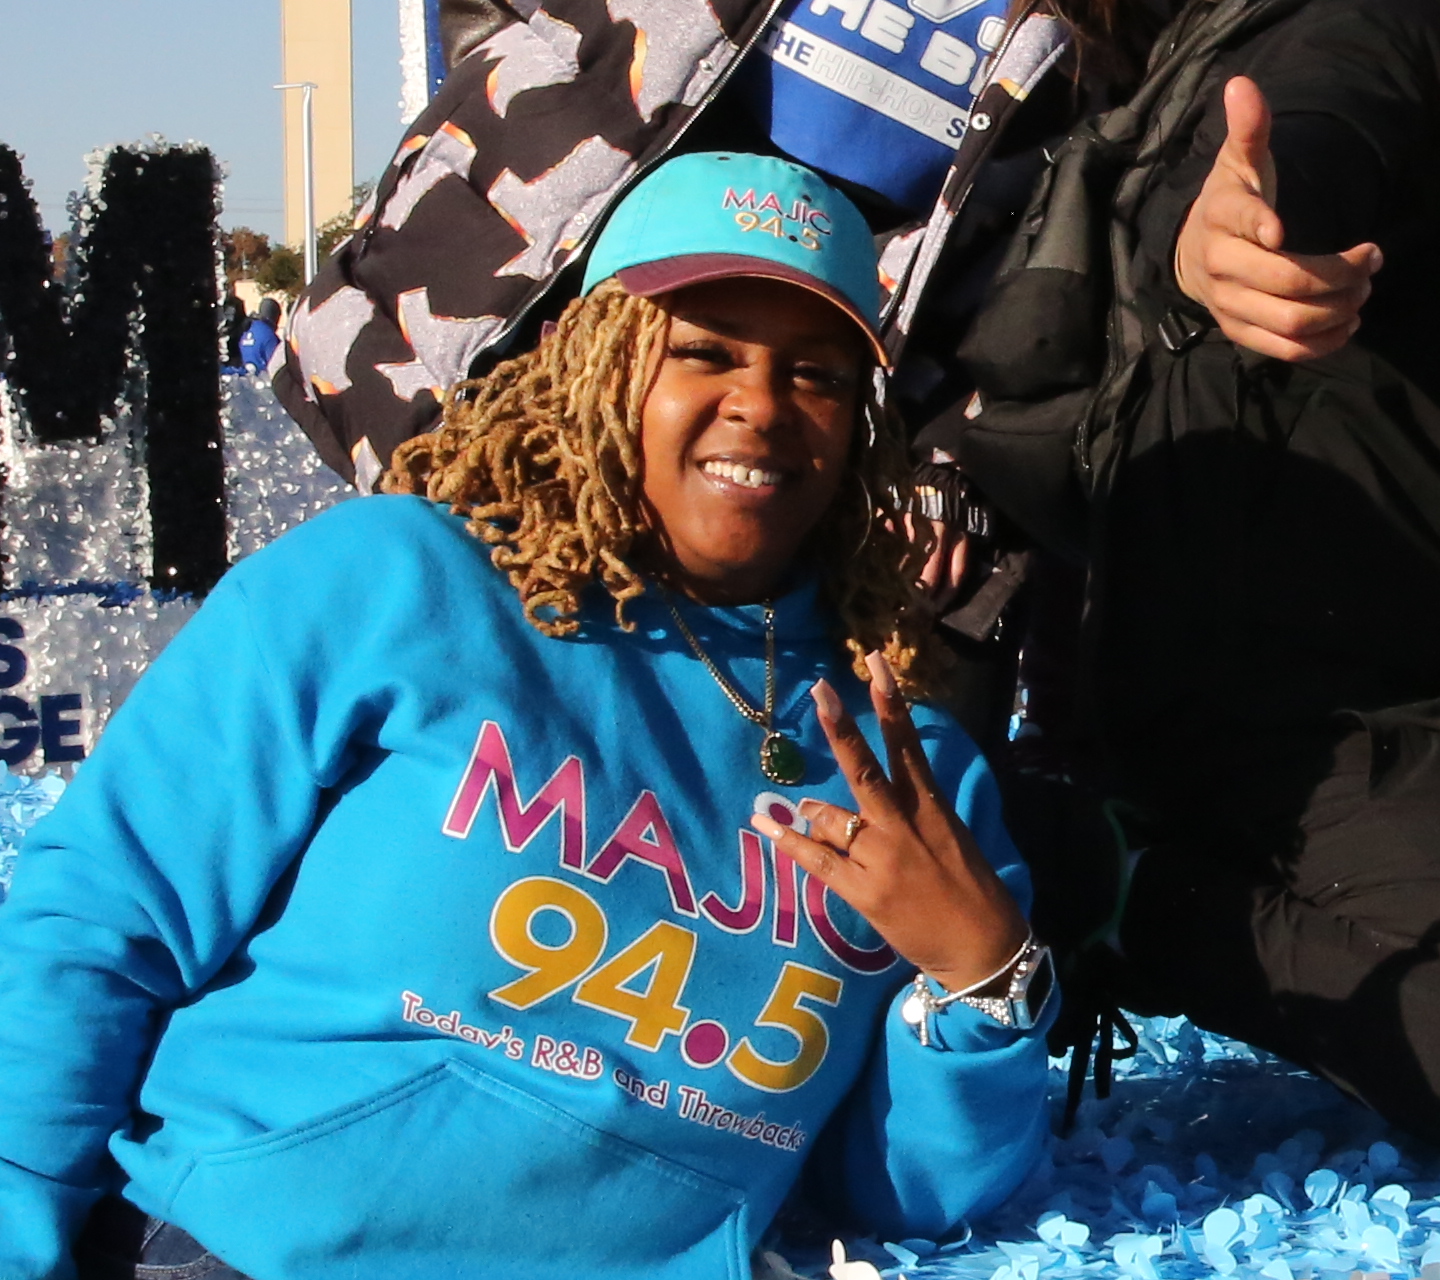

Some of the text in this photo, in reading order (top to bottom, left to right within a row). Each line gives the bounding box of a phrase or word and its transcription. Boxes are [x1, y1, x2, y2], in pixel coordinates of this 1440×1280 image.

[721, 186, 832, 237] MAJIC
[733, 211, 822, 252] 94.5
[488, 875, 843, 1094] 94.5
[400, 990, 808, 1152] Today's R&B and Throwbacks
